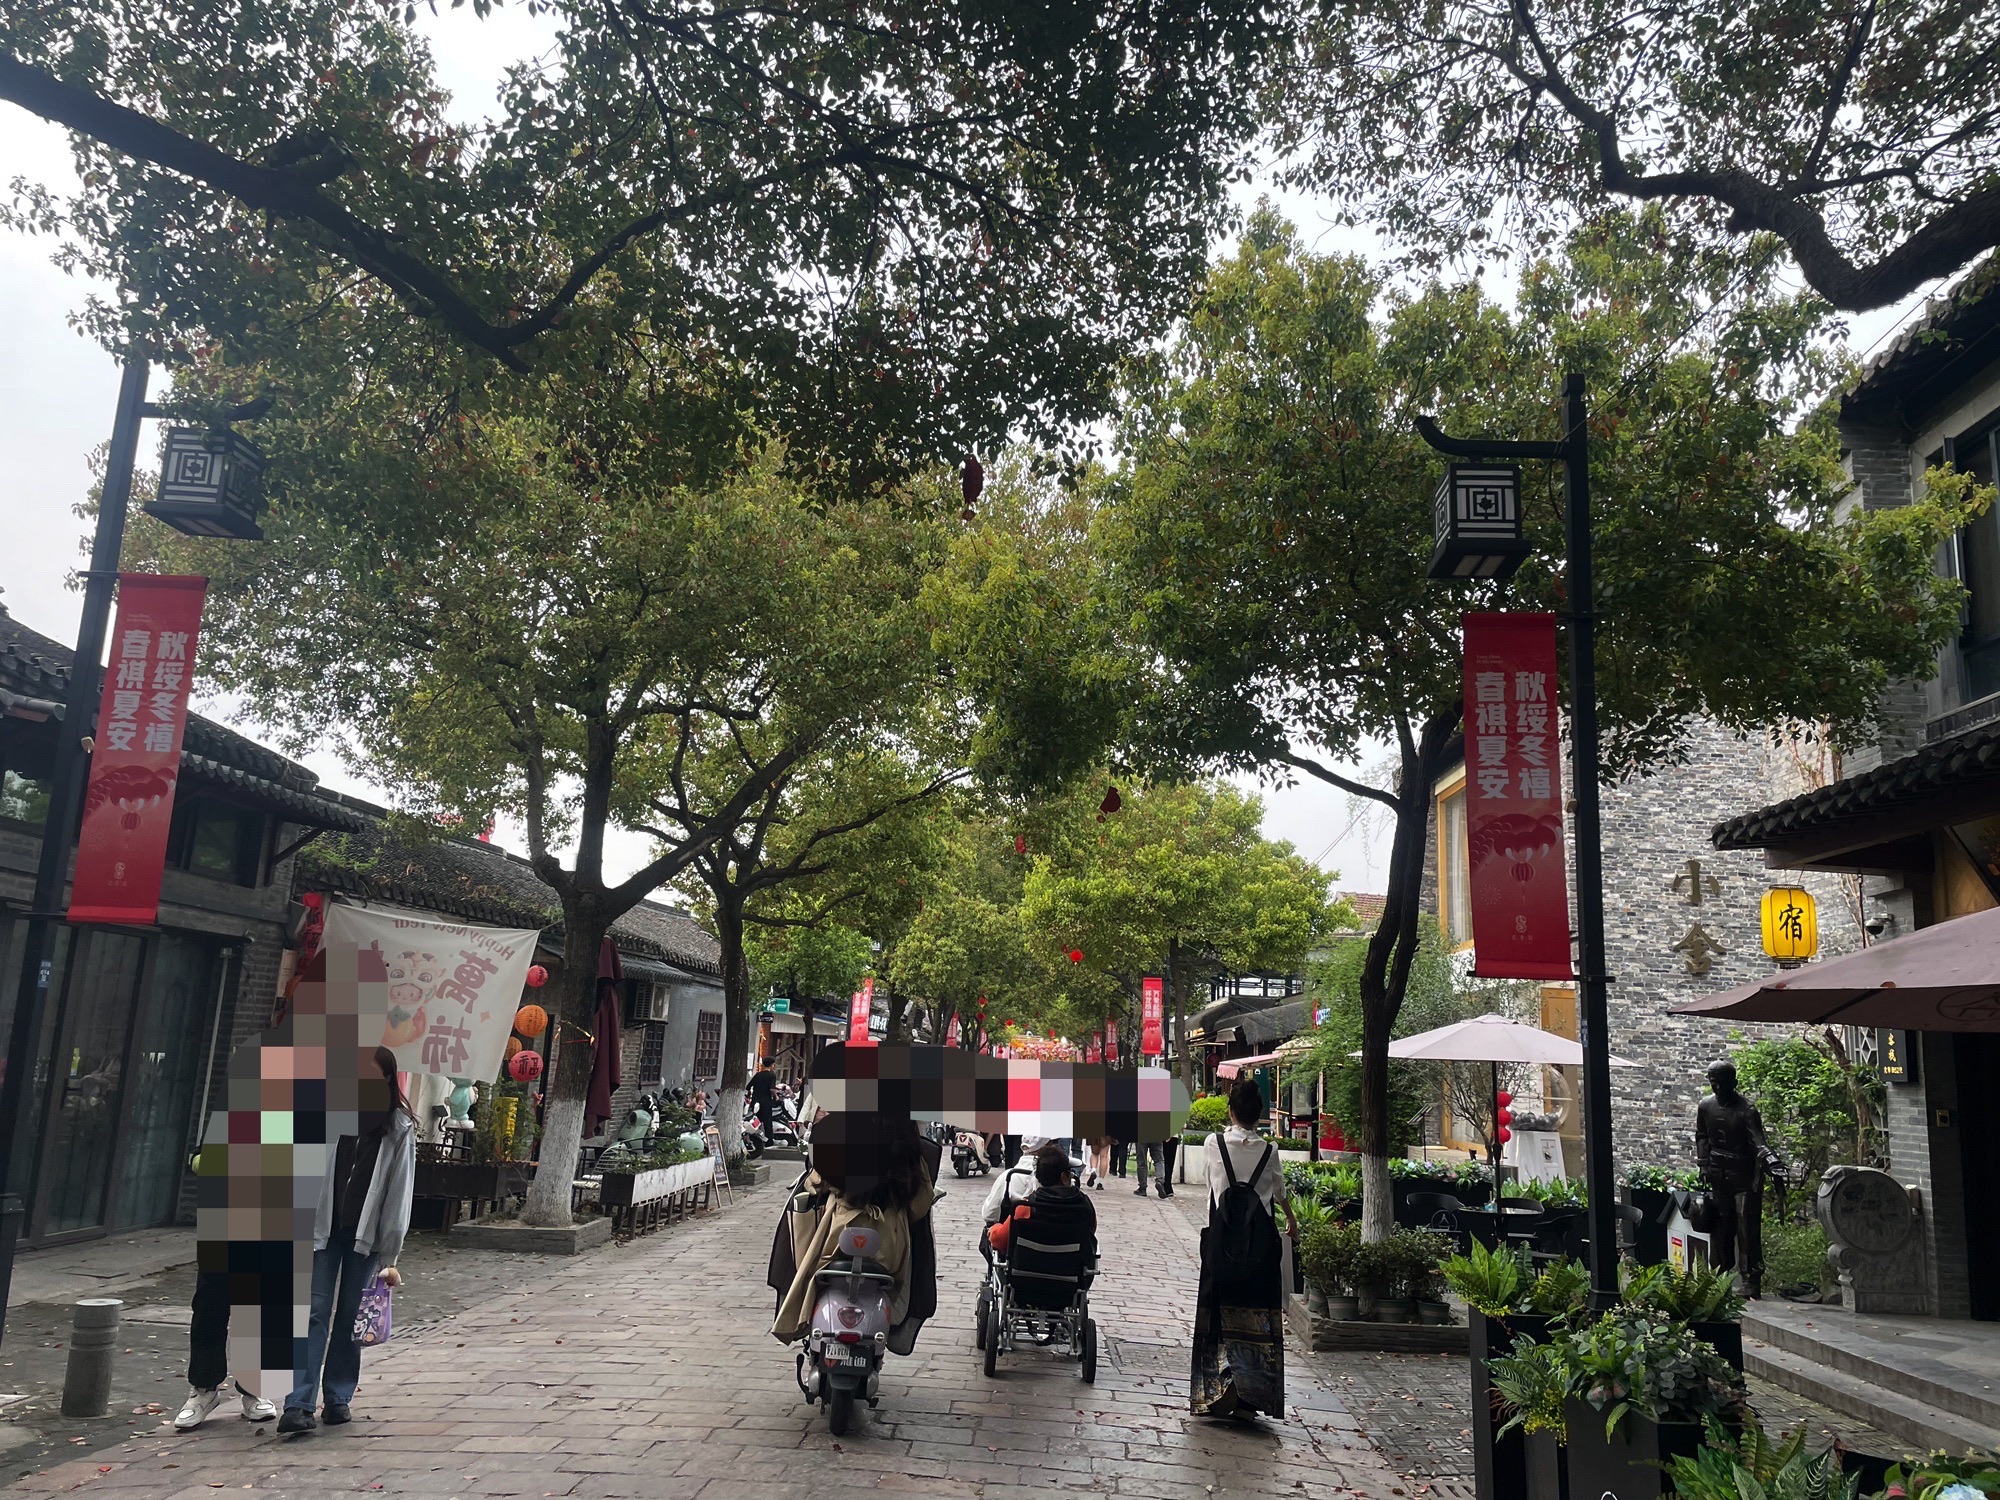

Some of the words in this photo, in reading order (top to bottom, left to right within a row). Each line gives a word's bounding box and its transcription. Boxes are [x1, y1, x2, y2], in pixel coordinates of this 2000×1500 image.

[106, 629, 151, 751] 春祺夏安
[143, 631, 189, 753] 秋绥冬禧
[1475, 671, 1509, 799] 春祺夏安
[1515, 671, 1551, 799] 秋绥冬禧
[1778, 904, 1804, 941] 宿
[518, 1054, 539, 1076] 福
